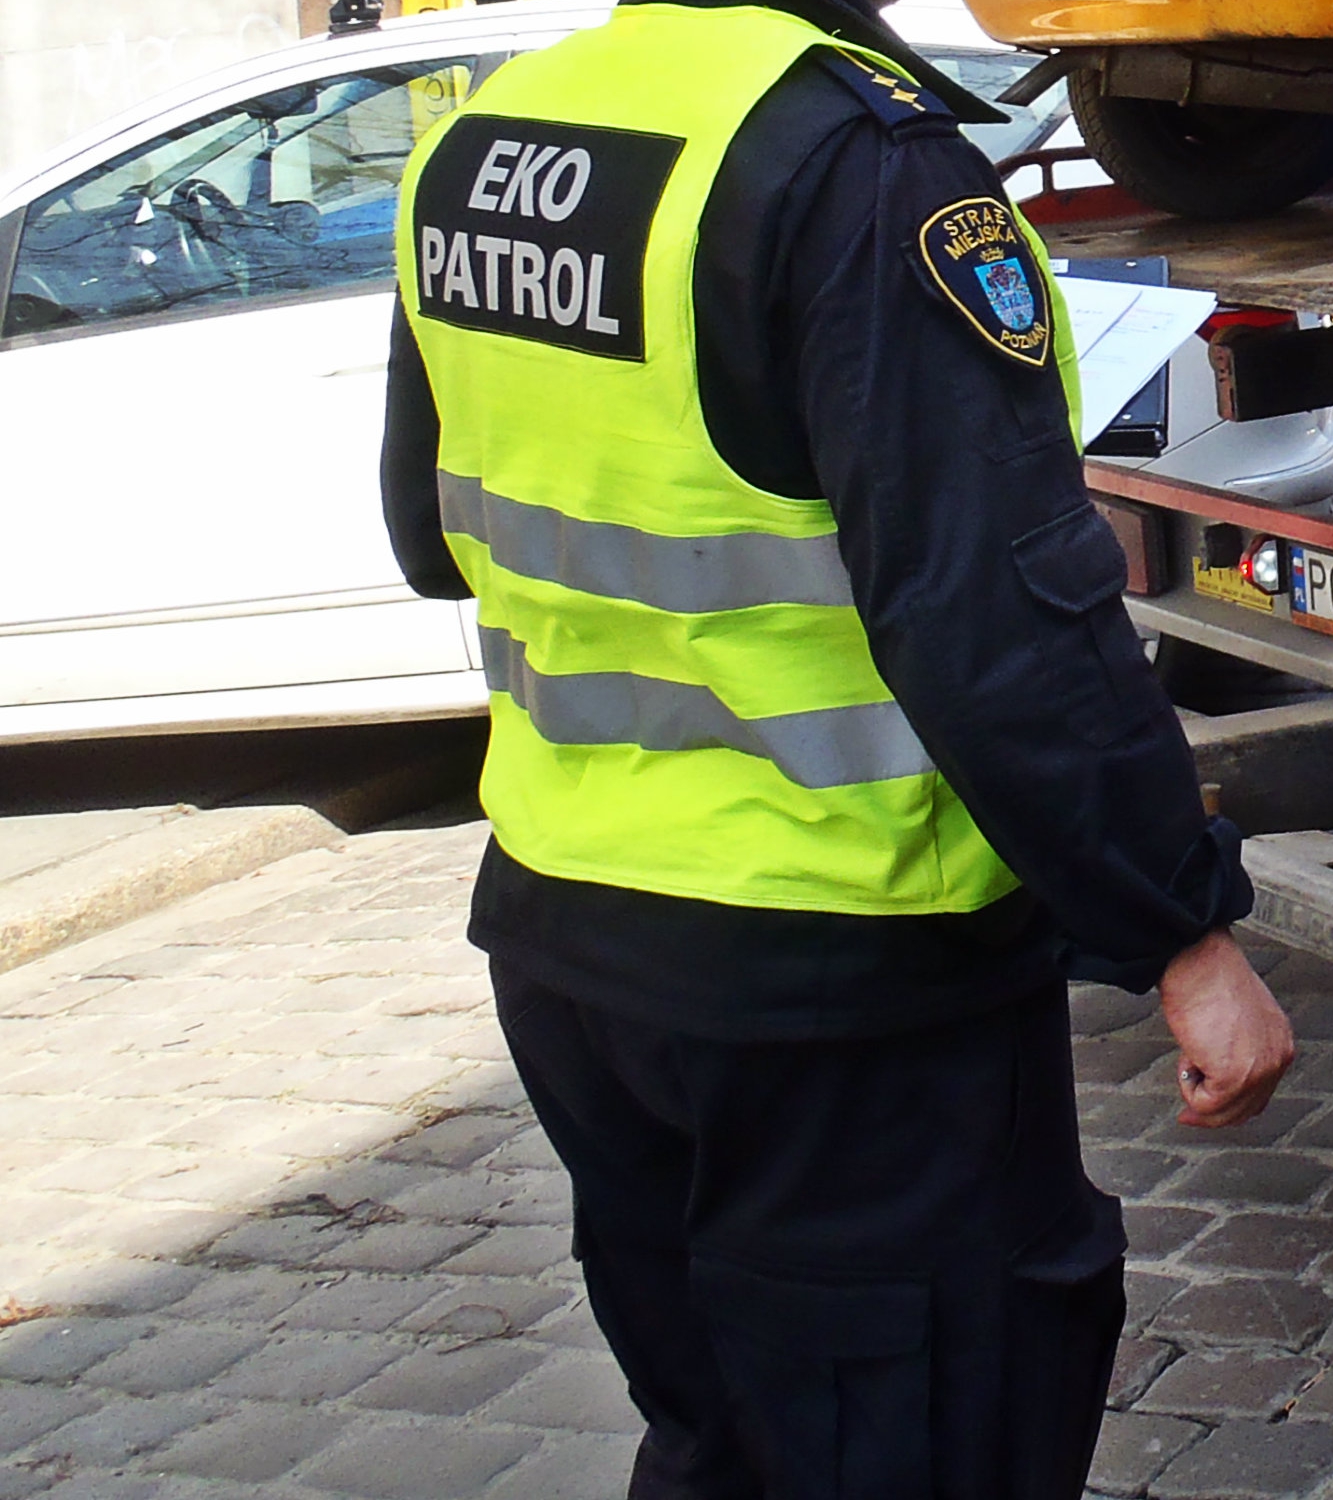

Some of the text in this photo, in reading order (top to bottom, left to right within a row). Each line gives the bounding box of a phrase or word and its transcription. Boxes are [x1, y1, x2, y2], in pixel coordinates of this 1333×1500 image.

[468, 140, 592, 222] EKO
[943, 207, 1007, 237] STRAŻ
[944, 225, 1017, 260] MIEJSKA
[422, 225, 620, 335] PATROL
[1293, 585, 1306, 605] PL
